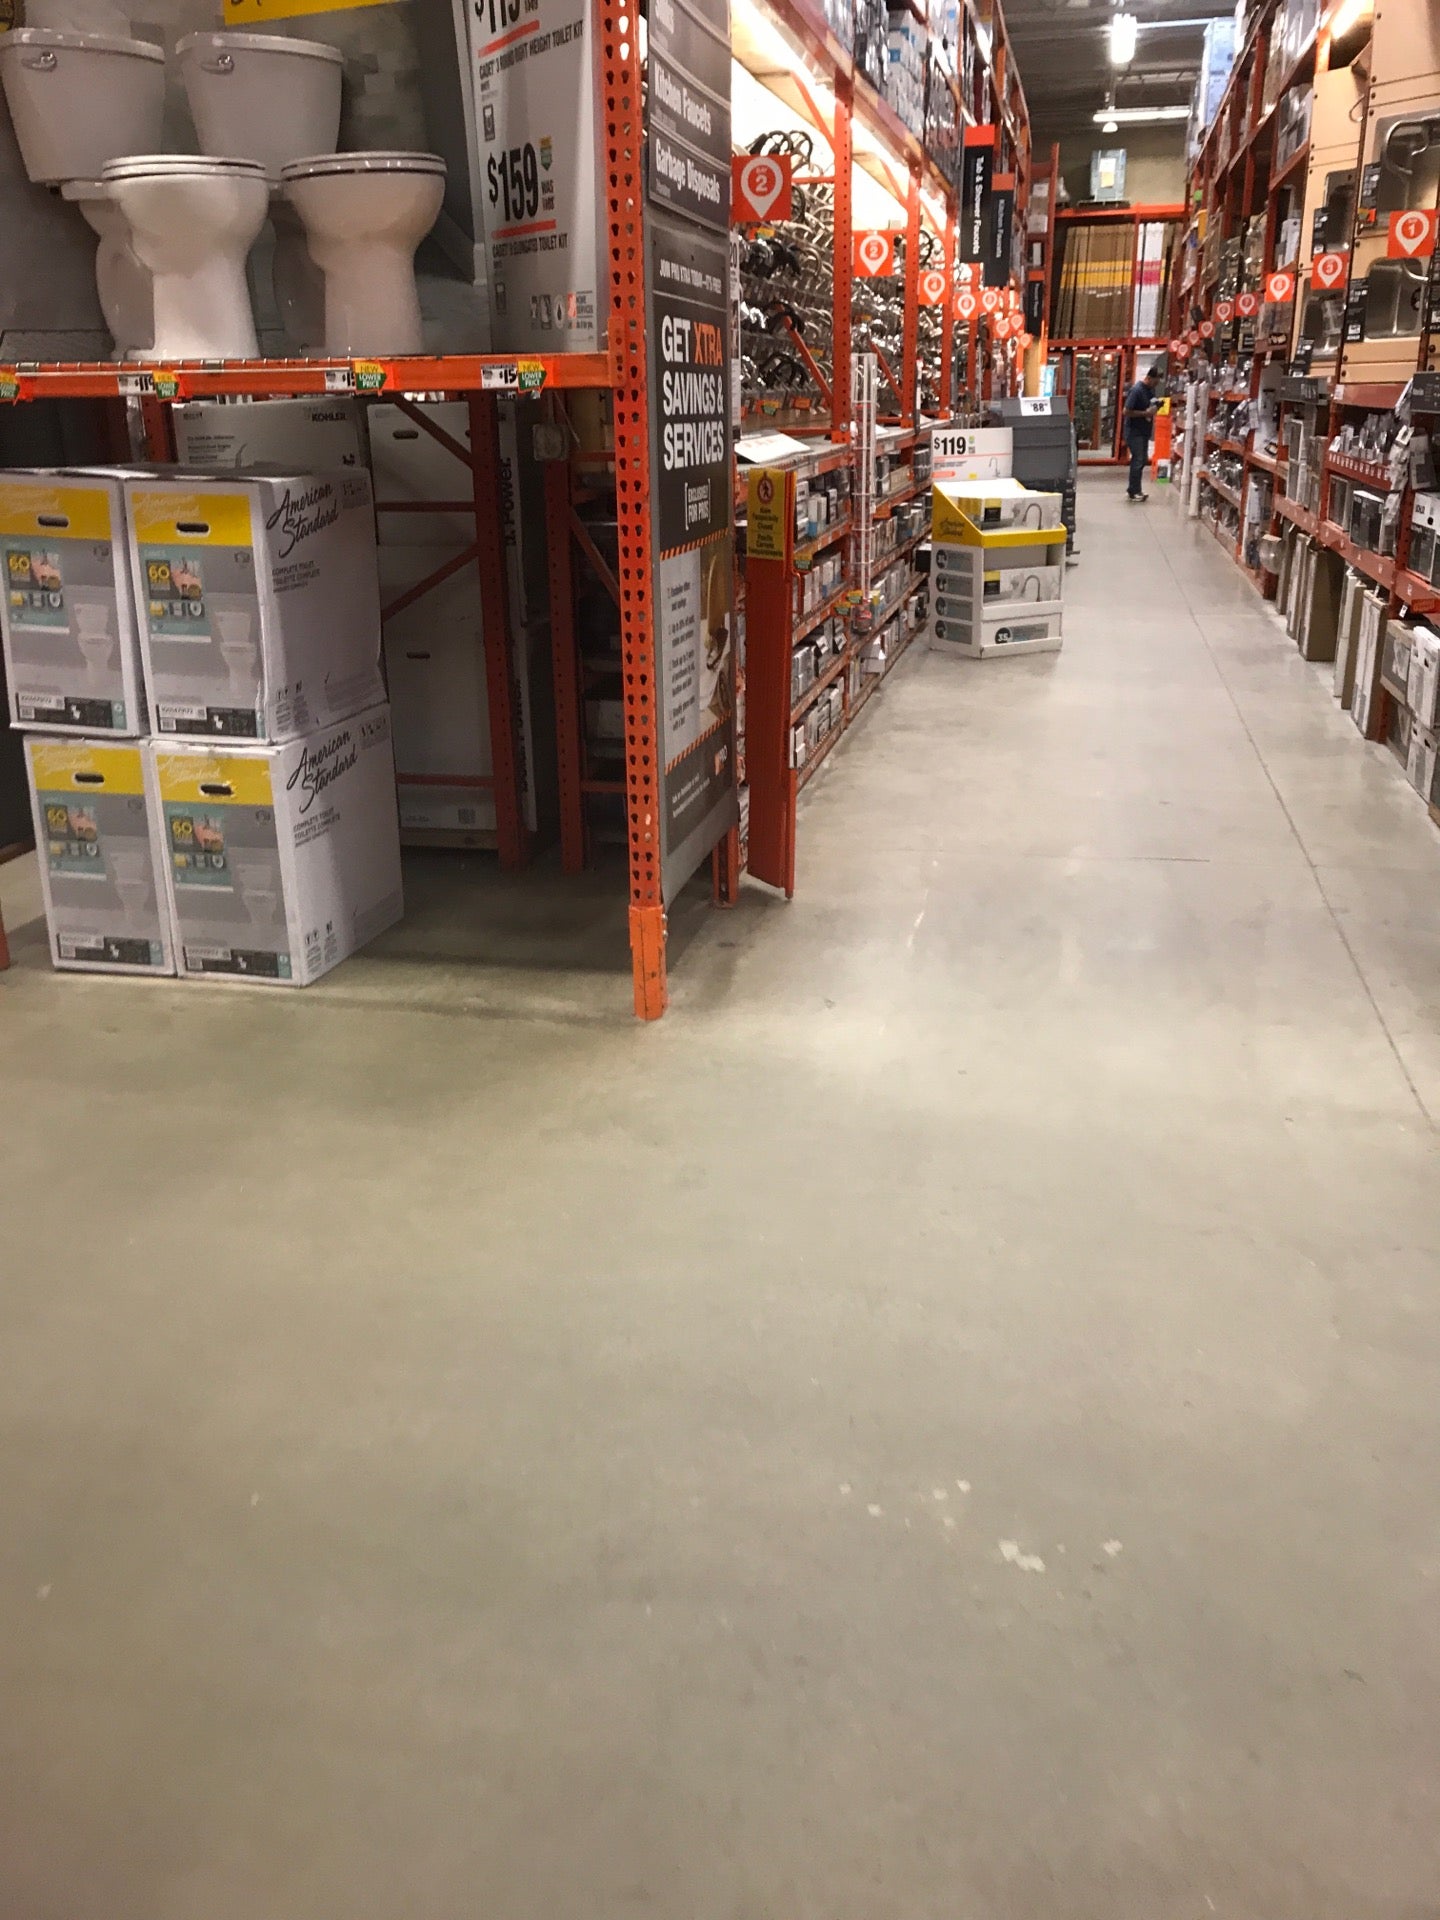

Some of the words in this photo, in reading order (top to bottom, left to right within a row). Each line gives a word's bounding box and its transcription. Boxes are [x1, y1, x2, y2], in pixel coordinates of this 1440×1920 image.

[552, 24, 572, 48] TOILET
[574, 19, 584, 39] KIT
[655, 60, 682, 115] Kitchen
[683, 87, 711, 136] Faucets
[487, 142, 539, 222] $159
[656, 138, 686, 191] Garbage
[687, 158, 720, 204] Disposals
[755, 174, 768, 192] 2
[974, 184, 983, 218] Shower
[558, 232, 568, 249] KIT
[973, 219, 982, 255] Faucets
[662, 314, 691, 363] GET
[694, 321, 723, 367] XTRA
[359, 373, 381, 381] LOWER
[362, 380, 380, 388] PRICE
[522, 372, 542, 380] LOWER
[663, 370, 716, 417] SAVINGS
[717, 374, 724, 415] &
[312, 412, 346, 422] KOHLER
[663, 420, 724, 471] SERVICES
[933, 436, 966, 455] $119
[266, 483, 333, 530] American
[278, 498, 339, 558] Standard
[286, 730, 351, 791] American
[299, 743, 358, 814] Standard
[293, 816, 318, 833] COMPLETE
